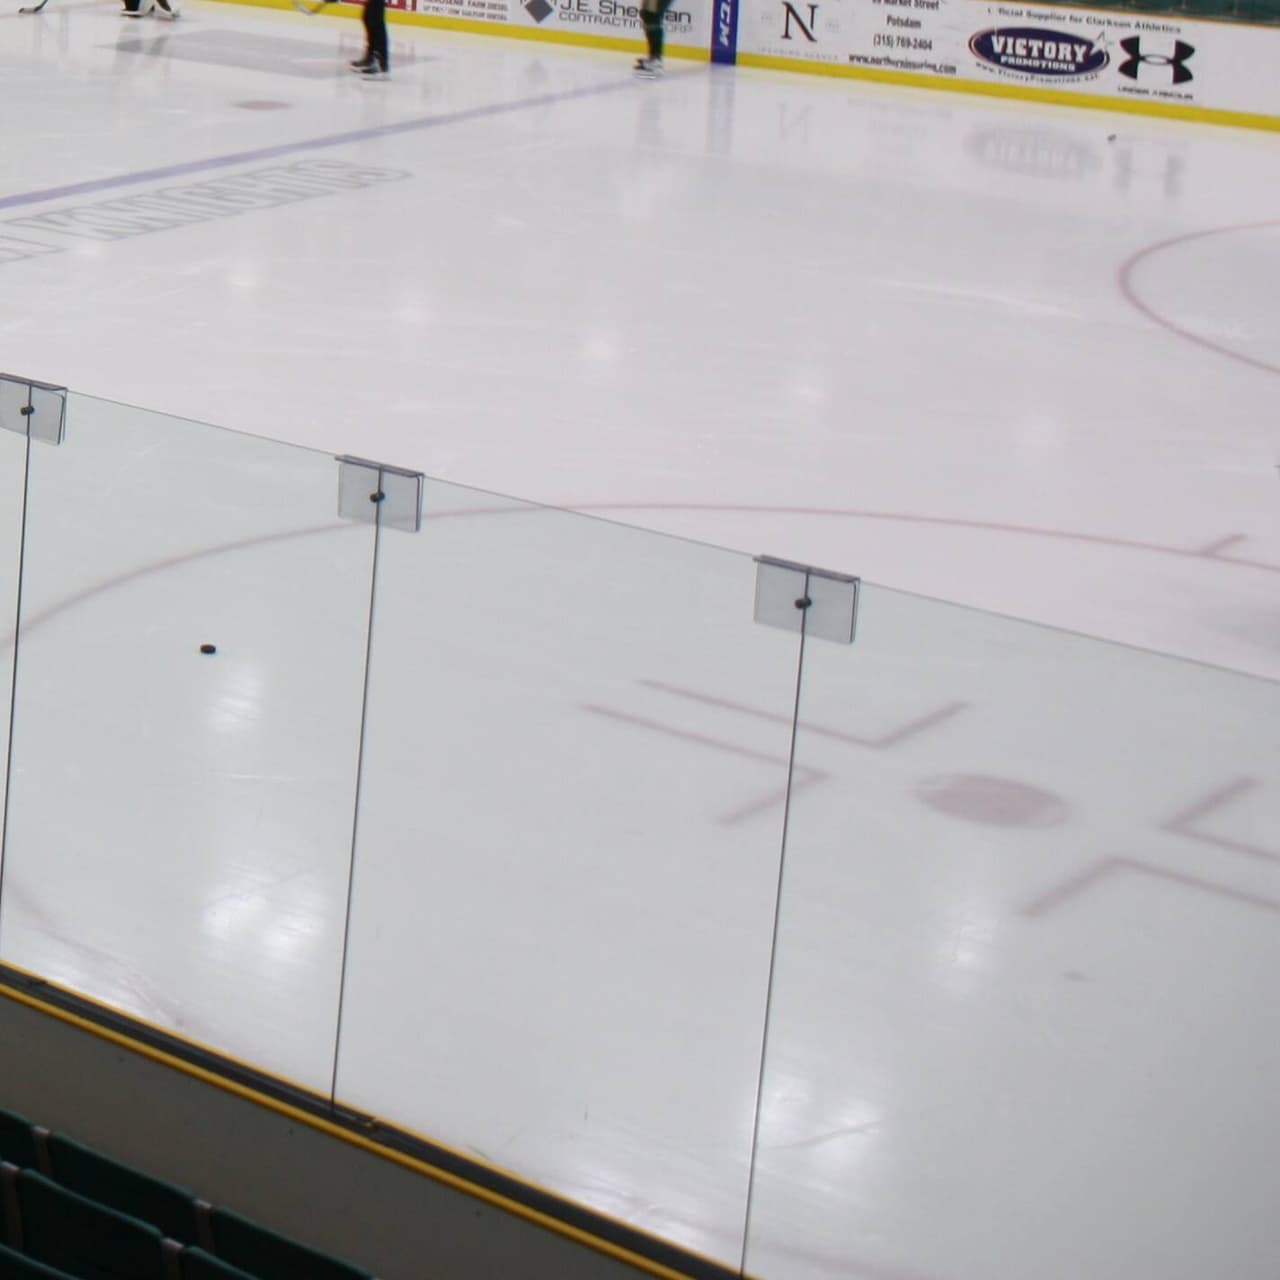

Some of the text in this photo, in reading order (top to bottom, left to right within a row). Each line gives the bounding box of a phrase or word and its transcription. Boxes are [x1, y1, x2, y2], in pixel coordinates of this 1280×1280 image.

[781, 1, 819, 42] N
[886, 15, 922, 29] Potsdam
[1026, 10, 1182, 34] Supplier for Clarkson Athletics
[872, 33, 933, 51] (315) 769-2404
[990, 34, 1087, 62] VICTORY
[1000, 55, 1076, 73] PROMOTIONS
